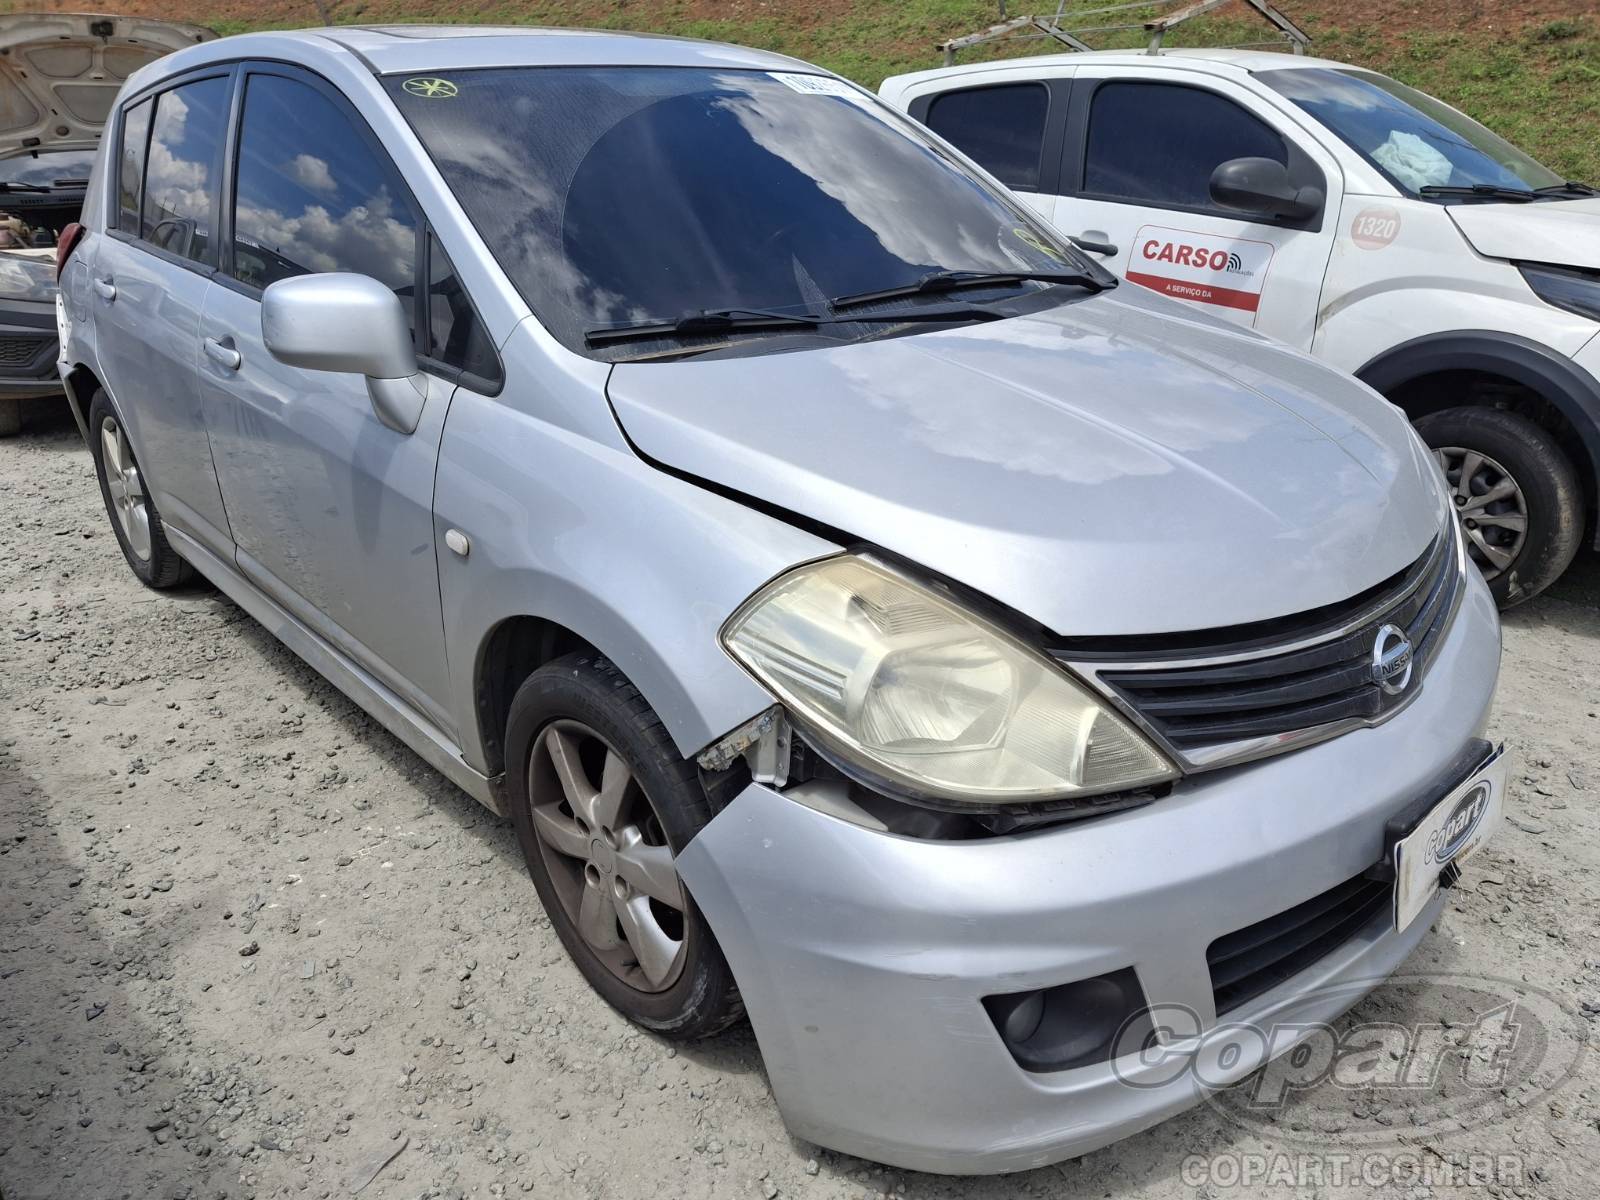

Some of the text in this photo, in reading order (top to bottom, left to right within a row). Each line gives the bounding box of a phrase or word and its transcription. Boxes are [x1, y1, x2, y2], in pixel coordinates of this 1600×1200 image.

[1357, 216, 1396, 238] 1320
[1143, 240, 1228, 271] CARSO
[1172, 285, 1201, 296] SERVIÇO
[1424, 790, 1484, 865] Copart
